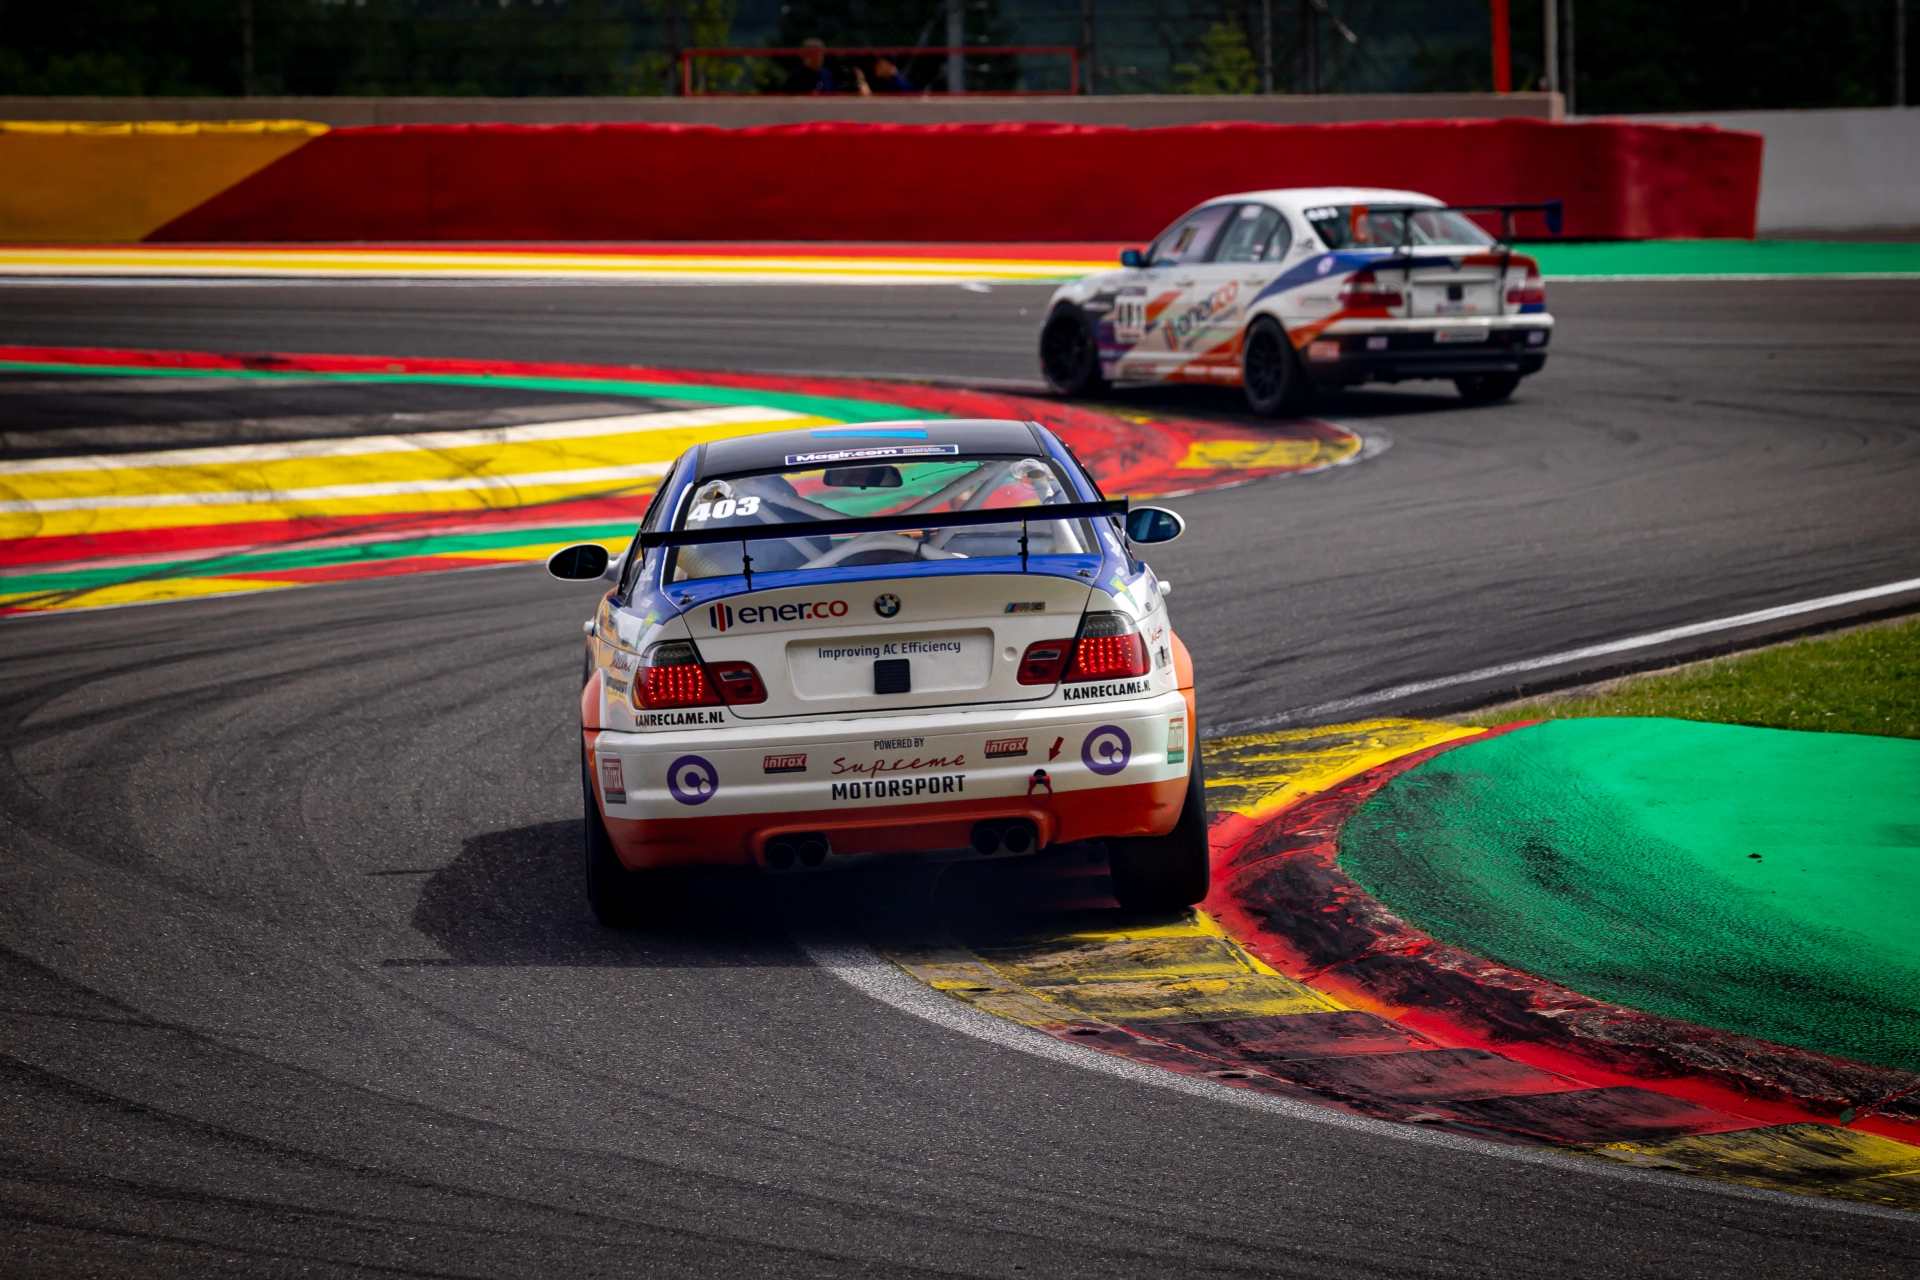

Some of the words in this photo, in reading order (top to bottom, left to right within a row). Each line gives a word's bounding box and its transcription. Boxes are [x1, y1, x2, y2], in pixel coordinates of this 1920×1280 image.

[687, 496, 760, 521] 403
[738, 600, 848, 623] ener.co
[818, 645, 880, 660] Improving
[883, 643, 898, 655] AC
[901, 641, 961, 653] Efficiency
[874, 739, 912, 750] POWERED
[914, 737, 925, 748] BY
[831, 754, 966, 779] Supreme
[832, 775, 966, 800] MOTORSPORT
